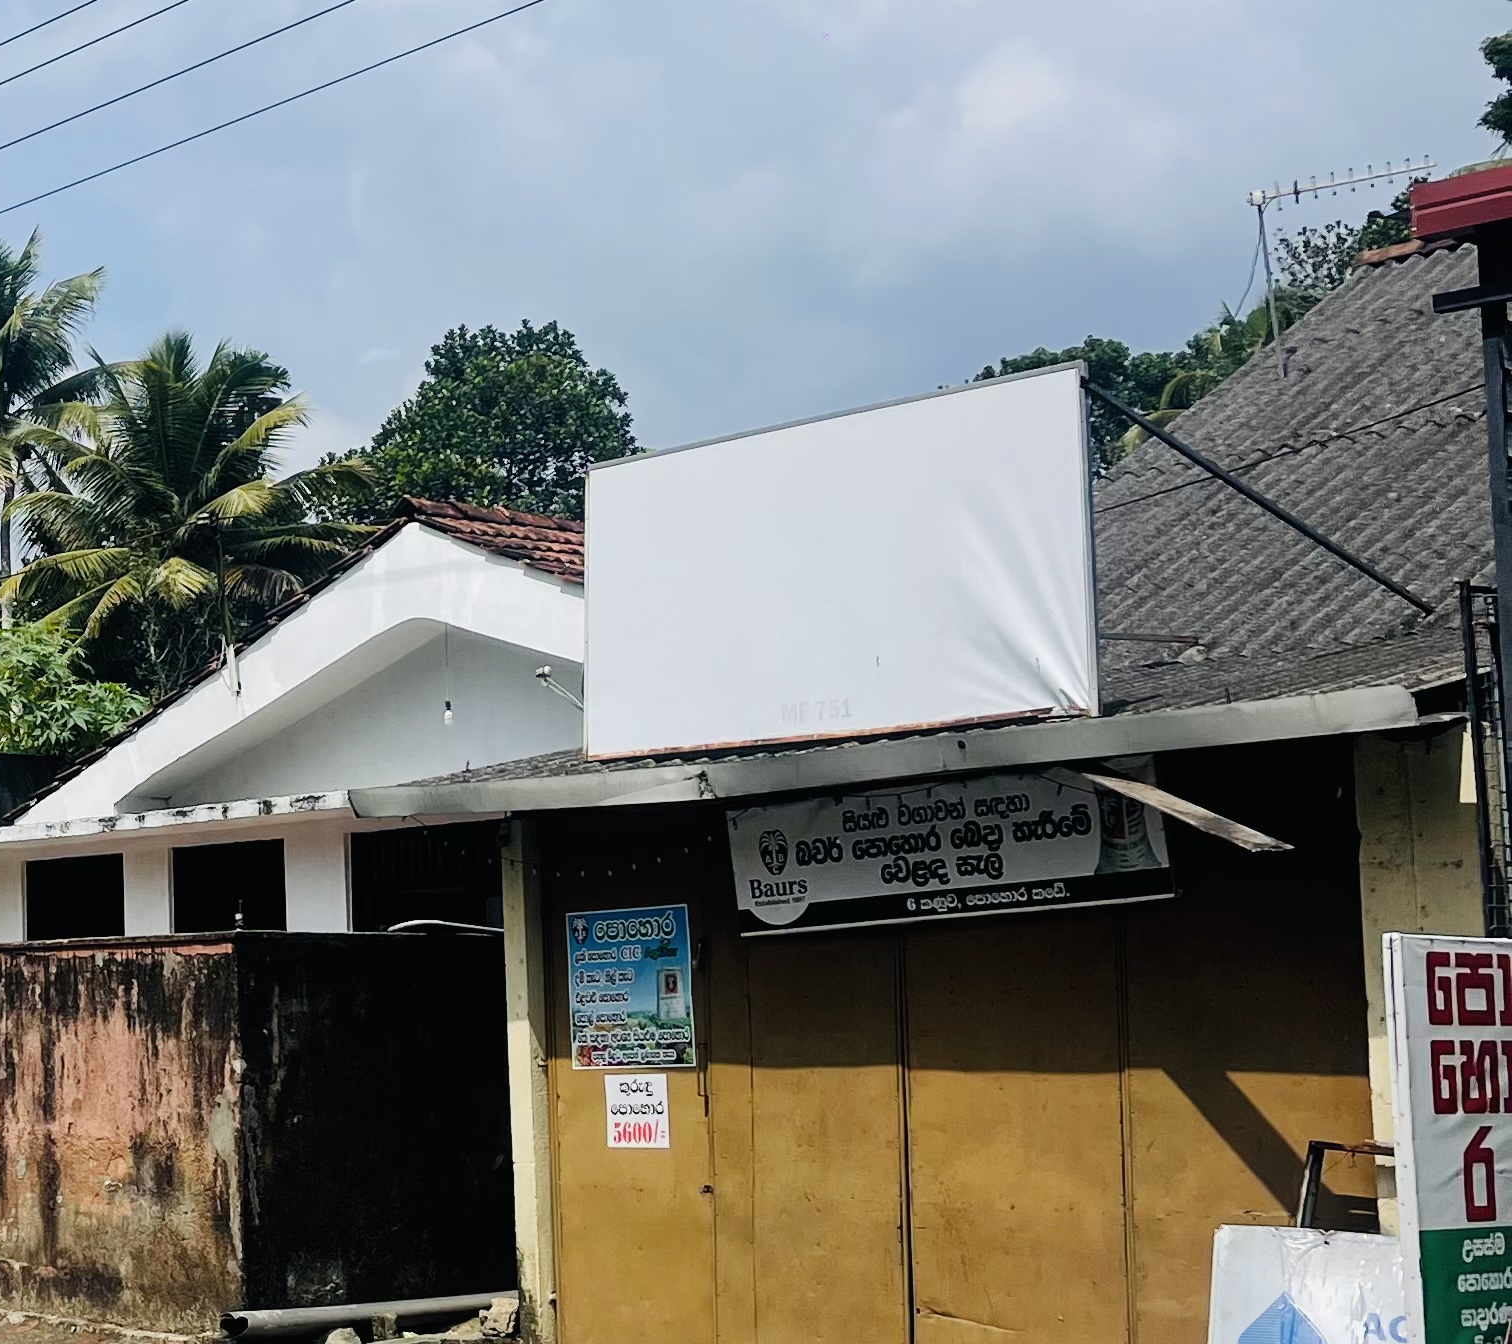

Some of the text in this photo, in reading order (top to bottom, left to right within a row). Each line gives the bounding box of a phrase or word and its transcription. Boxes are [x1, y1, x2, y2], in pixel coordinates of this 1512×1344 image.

[897, 796, 966, 826] වගාවන්
[974, 793, 1030, 819] සඳහා
[852, 824, 941, 860] පොහොර
[950, 820, 1004, 852] බෙදා
[956, 853, 1004, 880] සැල
[749, 878, 808, 899] Baurs
[906, 897, 916, 911] 6
[966, 886, 1028, 906] පොහොර
[594, 912, 675, 941] පොහොර
[620, 946, 641, 960] CIC
[610, 1101, 664, 1115] පොහොර
[613, 1119, 665, 1144] 5600/=
